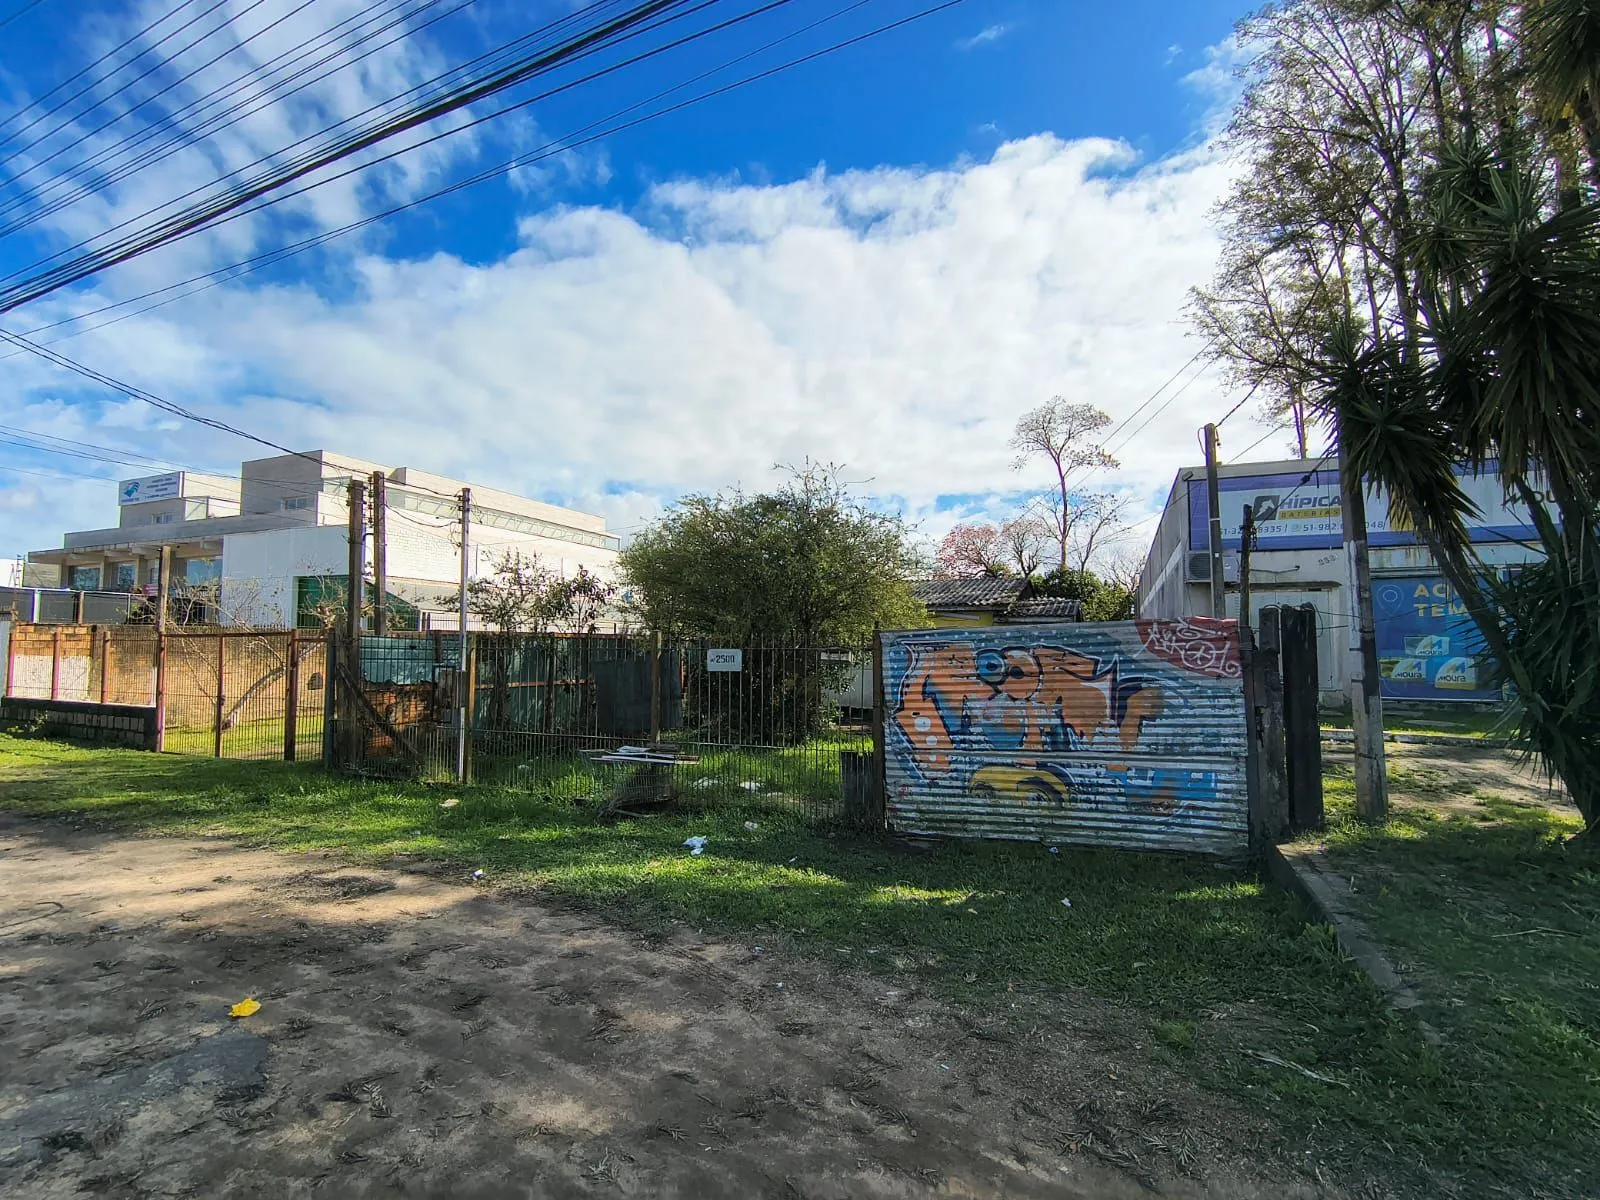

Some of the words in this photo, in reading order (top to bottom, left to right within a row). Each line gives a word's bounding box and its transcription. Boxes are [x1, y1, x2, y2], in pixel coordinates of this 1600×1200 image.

[1280, 495, 1341, 509] HÍPICA
[1280, 509, 1339, 519] BATERIAS
[1413, 603, 1467, 617] TEM
